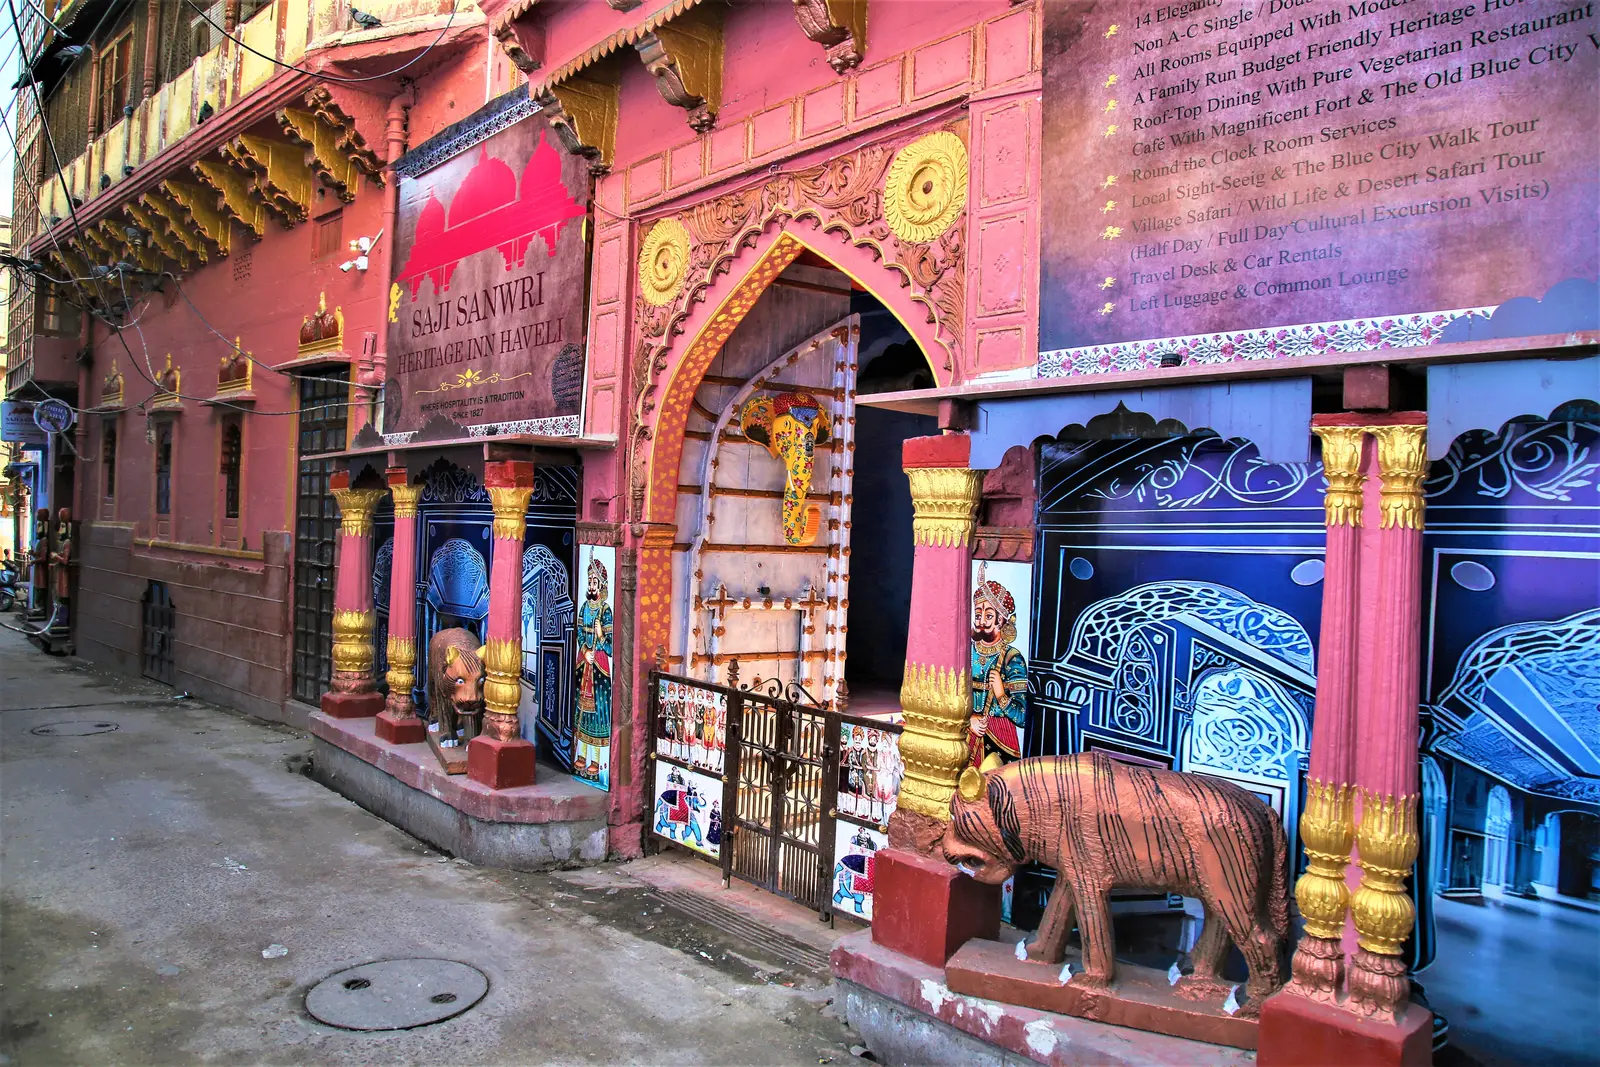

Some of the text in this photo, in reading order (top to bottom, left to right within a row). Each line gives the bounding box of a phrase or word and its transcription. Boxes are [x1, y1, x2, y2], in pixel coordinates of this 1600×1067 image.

[1133, 37, 1164, 55] Non
[1167, 24, 1200, 44] A-C
[1204, 8, 1254, 34] Single
[1269, 0, 1313, 14] Dou
[1133, 63, 1155, 80] All
[1160, 50, 1212, 72] Rooms
[1217, 21, 1295, 56] Equipped
[1300, 10, 1341, 32] With
[1133, 0, 1525, 106] A Family Run Budget Friendly Heritage Ho
[1135, 11, 1151, 29] 14
[1132, 138, 1165, 156] Café
[1170, 125, 1205, 146] With
[1211, 103, 1309, 142] Magnificent
[1314, 97, 1352, 116] Fort
[1357, 88, 1375, 106] &
[1381, 80, 1418, 99] The
[1424, 68, 1462, 90] Old
[1470, 58, 1521, 80] Blue
[1528, 42, 1580, 65] City
[1133, 104, 1202, 131] Roof-Top
[1207, 89, 1262, 114] Dining
[1266, 74, 1306, 97] With
[1312, 67, 1353, 87] Pure
[1358, 39, 1462, 74] Vegetarian
[1469, 2, 1594, 48] Restaurant
[1132, 117, 1397, 183] Round the Clock Room Services
[1132, 118, 1540, 208] Local Sight-Seeig & The Blue City Walk Tour
[1130, 241, 1170, 262] (Half
[1173, 237, 1202, 254] Day
[1218, 228, 1249, 246] Full
[1255, 223, 1289, 241] Day
[1295, 208, 1366, 235] Cultural
[1373, 194, 1472, 222] Excursion
[1480, 179, 1550, 205] Visits)
[1132, 213, 1182, 234] Village
[1187, 204, 1232, 223] Safari
[1248, 194, 1287, 213] Wild
[1293, 188, 1328, 206] Life
[1334, 183, 1351, 197] &
[1358, 172, 1419, 195] Desert
[1426, 157, 1486, 183] Safari
[1492, 149, 1546, 171] Tour
[1130, 243, 1342, 285] Travel Desk & Car Rentals
[1130, 265, 1409, 311] Left Luggage & Common Lounge
[411, 272, 545, 338] SAJI SANWRI
[398, 318, 564, 375] HERITAGE INN HAVELI
[421, 403, 440, 412] WHERE
[441, 398, 477, 409] HOSPITALITY
[490, 391, 524, 403] TRADITION
[470, 409, 483, 417] 1827
